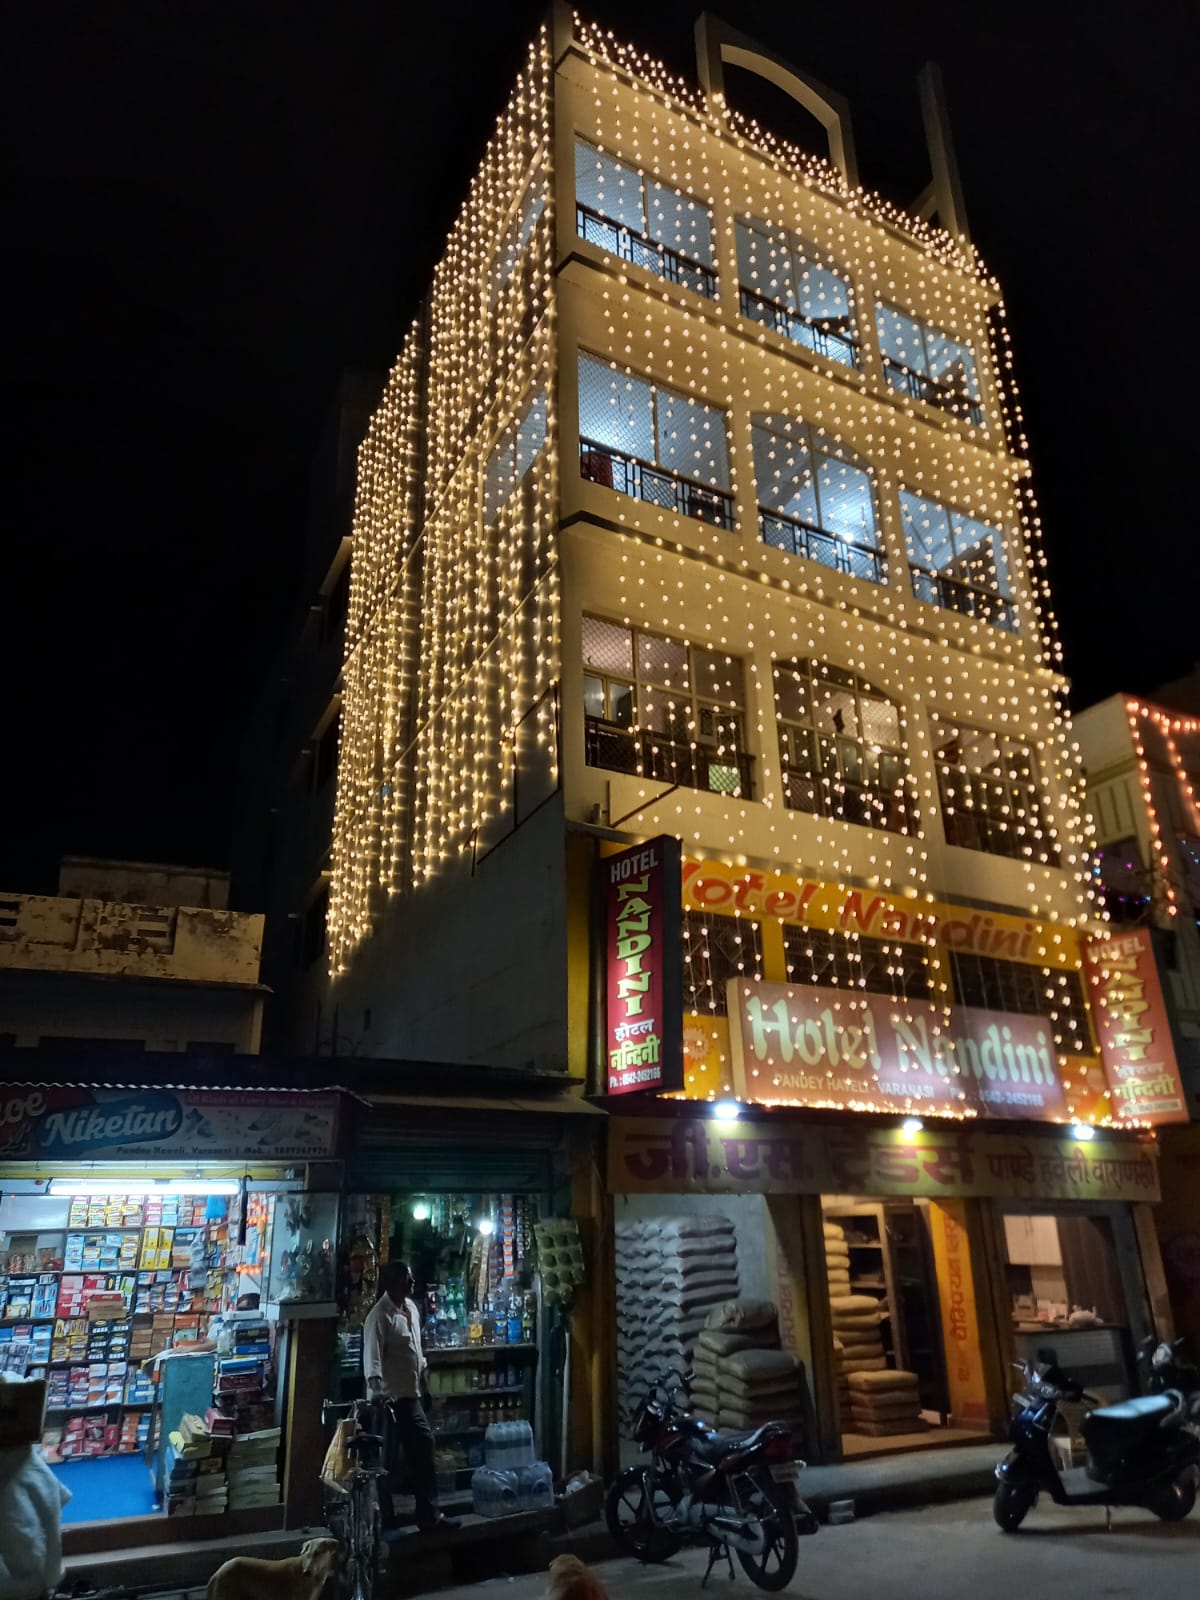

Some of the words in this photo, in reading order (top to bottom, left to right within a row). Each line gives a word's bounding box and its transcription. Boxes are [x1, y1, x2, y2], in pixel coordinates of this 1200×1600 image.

[610, 848, 659, 884] HOTEL
[616, 874, 653, 1018] NANDINI
[840, 891, 1038, 956] Nandini
[609, 1034, 661, 1071] नन्दिनी
[613, 1018, 655, 1042] होटल
[746, 995, 882, 1071] Hotel
[890, 1014, 1055, 1086] Nandini
[774, 1073, 825, 1091] PANDEY
[877, 1080, 935, 1098] VARANASI
[0, 1091, 47, 1126] oe
[41, 1097, 181, 1148] Niketan
